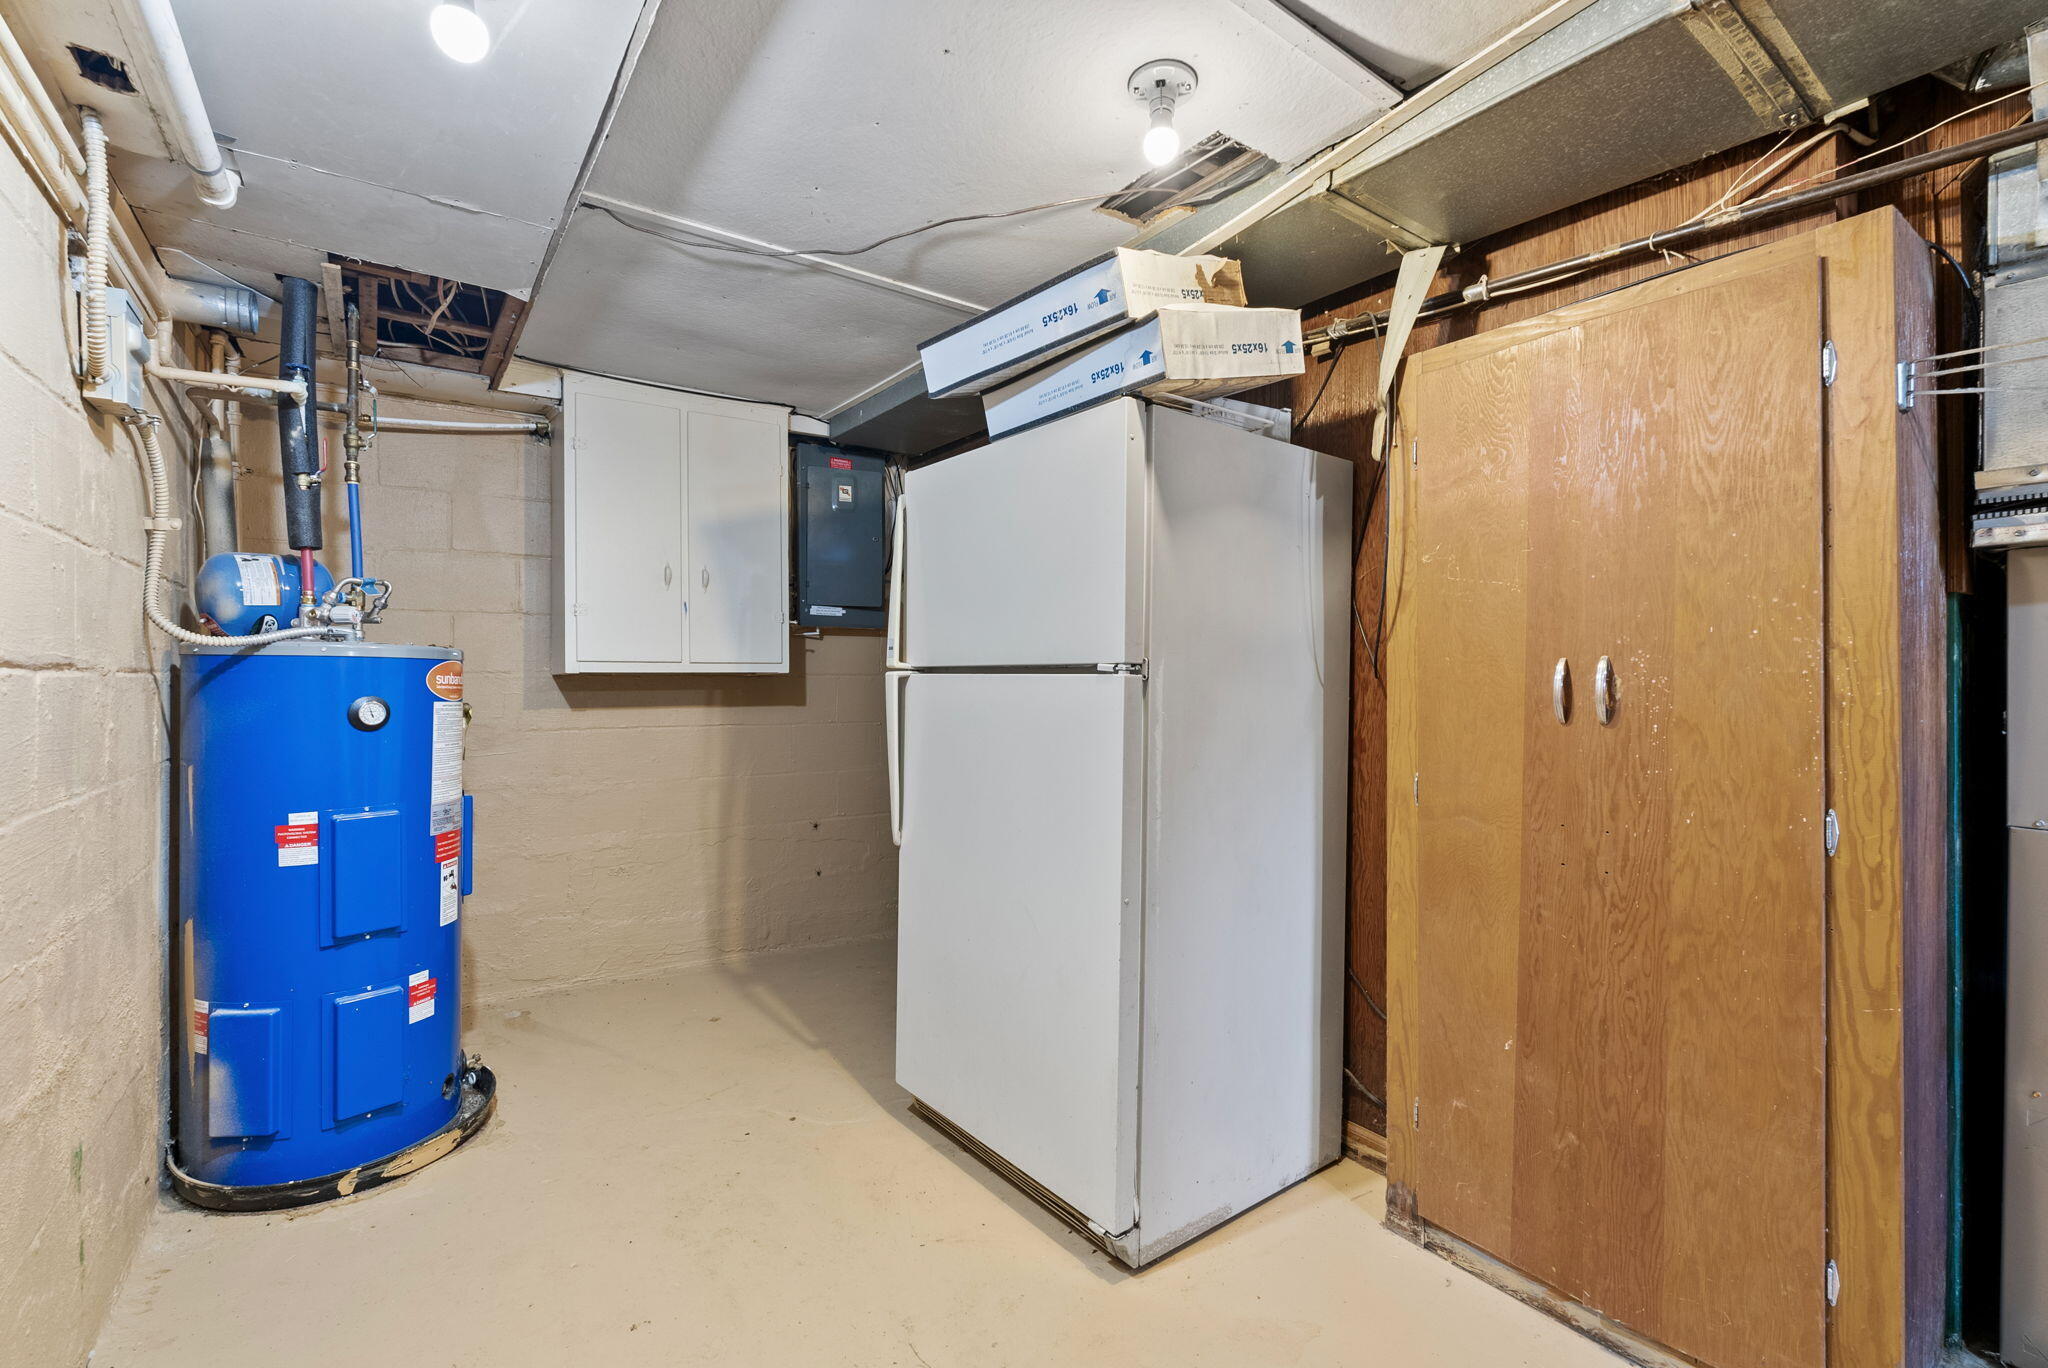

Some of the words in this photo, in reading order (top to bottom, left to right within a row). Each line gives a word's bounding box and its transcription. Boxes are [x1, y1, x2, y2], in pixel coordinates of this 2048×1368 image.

[1041, 303, 1079, 328] 16x25x5
[1231, 342, 1268, 354] 16x25x5
[1090, 362, 1125, 384] 16x25x5
